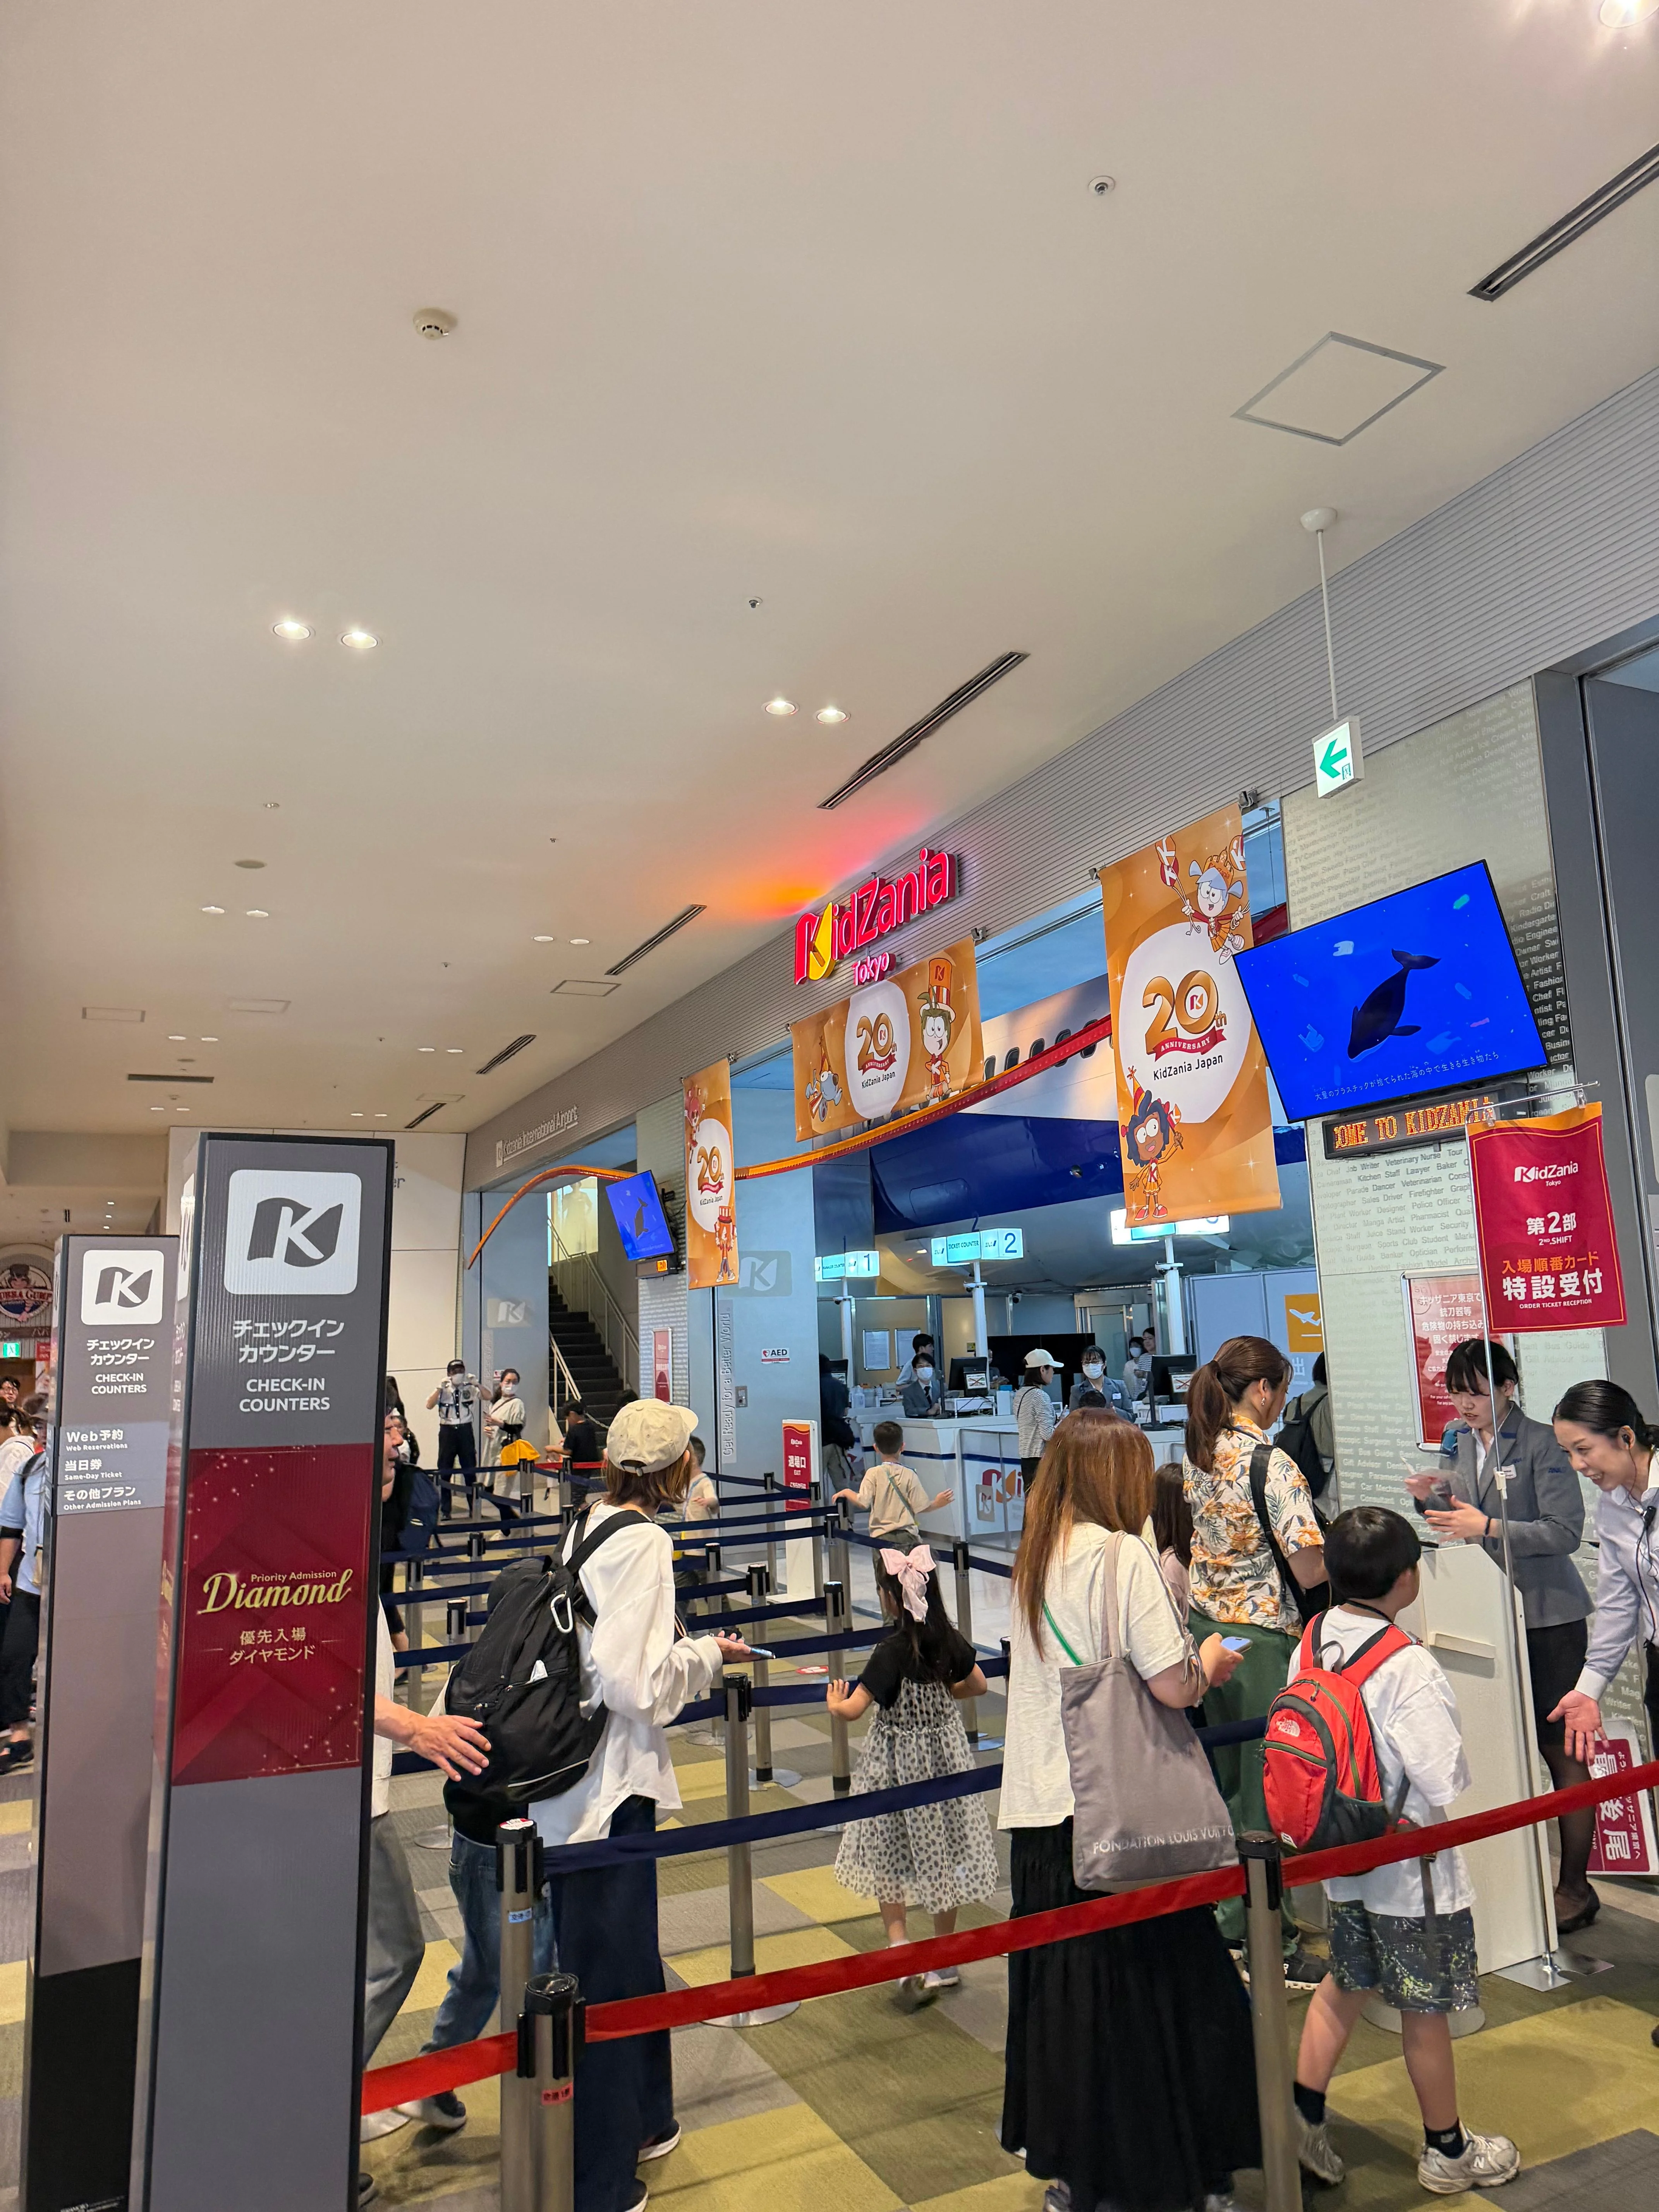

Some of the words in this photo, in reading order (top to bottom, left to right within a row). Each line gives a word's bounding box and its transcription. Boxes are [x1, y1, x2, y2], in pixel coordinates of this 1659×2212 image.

[794, 847, 952, 986] KidZania
[1526, 926, 1558, 941] Enginee
[852, 951, 893, 987] Tokyo
[1532, 990, 1553, 1002] Chef
[1161, 1036, 1211, 1052] ANNIVERSARY
[866, 1059, 890, 1069] ANNIVERSARY
[1153, 1061, 1192, 1081] KidZania
[1195, 1054, 1223, 1069] Japan
[861, 1075, 881, 1089] KidZania
[881, 1071, 896, 1082] Japan
[522, 1114, 556, 1147] International
[556, 1104, 578, 1131] Airport
[1375, 1115, 1398, 1140] TO
[1404, 1096, 1494, 1137] KIDZANIA
[1385, 1155, 1419, 1166] Veterinary
[1420, 1152, 1441, 1161] Nurse
[1447, 1148, 1463, 1157] Tour
[1358, 1173, 1381, 1182] Kitchen
[1385, 1169, 1400, 1178] Staff
[1406, 1166, 1430, 1176] Lawyer
[1437, 1161, 1457, 1170] Baker
[1514, 1161, 1578, 1183] KidZania
[1346, 1186, 1369, 1196] Parade
[1372, 1183, 1396, 1191] Dancer
[1401, 1176, 1442, 1187] Veterinarian
[1362, 1196, 1379, 1204] Sales
[1383, 1192, 1403, 1201] Driver
[1409, 1187, 1444, 1199] Firefighter
[1349, 1209, 1371, 1217] Worker
[1377, 1204, 1406, 1215] Designer
[1412, 1200, 1433, 1209] Police
[1437, 1197, 1461, 1206] Officer
[1363, 1219, 1384, 1229] Manga
[1388, 1216, 1405, 1224] Artist
[1411, 1210, 1449, 1221] Pharmacist
[1526, 1211, 1577, 1235] 第2部
[1367, 1229, 1383, 1238] Juice
[1387, 1226, 1406, 1235] Stand
[1410, 1224, 1434, 1233] Worker
[1440, 1220, 1469, 1231] Security
[1004, 1233, 1017, 1253] 2
[1378, 1240, 1399, 1249] Sports
[1403, 1238, 1418, 1246] Club
[1422, 1234, 1449, 1244] Student
[1381, 1251, 1404, 1260] Banker
[1410, 1248, 1438, 1258] Optician
[1444, 1244, 1477, 1254] Performe
[864, 1253, 870, 1271] 1
[1396, 1260, 1423, 1269] Fashion
[1427, 1257, 1448, 1267] Model
[1501, 1251, 1599, 1274] 入場順番カード
[1503, 1267, 1603, 1301] 特設受付
[1563, 1298, 1592, 1307] RECEPTION
[233, 1319, 345, 1338] チェックイン
[720, 1313, 731, 1345] World
[86, 1338, 155, 1351] チェックイン
[239, 1344, 335, 1363] カウンター
[90, 1354, 149, 1366] カウンター
[721, 1346, 732, 1375] Better
[95, 1373, 144, 1383] CHECK-IN
[246, 1377, 325, 1392] CHECK-IN
[91, 1384, 147, 1395] COUNTERS
[722, 1387, 732, 1401] for
[239, 1396, 330, 1412] COUNTERS
[722, 1403, 735, 1436] Ready
[66, 1429, 124, 1443] Web予約
[83, 1443, 128, 1451] Reservations
[723, 1438, 733, 1456] Get
[64, 1458, 102, 1472] 当日券
[64, 1472, 99, 1480] Same-Day
[64, 1486, 136, 1501] その他プラン
[86, 1501, 122, 1509] Admission
[251, 1573, 287, 1583] Priority
[289, 1570, 337, 1580] Admission
[197, 1568, 353, 1615] Diamond
[240, 1627, 306, 1645] 優先入場
[229, 1645, 316, 1666] ダイヤモンド
[1092, 1835, 1165, 1854] FONDATION
[1169, 1829, 1198, 1844] LOUIS
[1201, 1824, 1234, 1839] VUITTO
